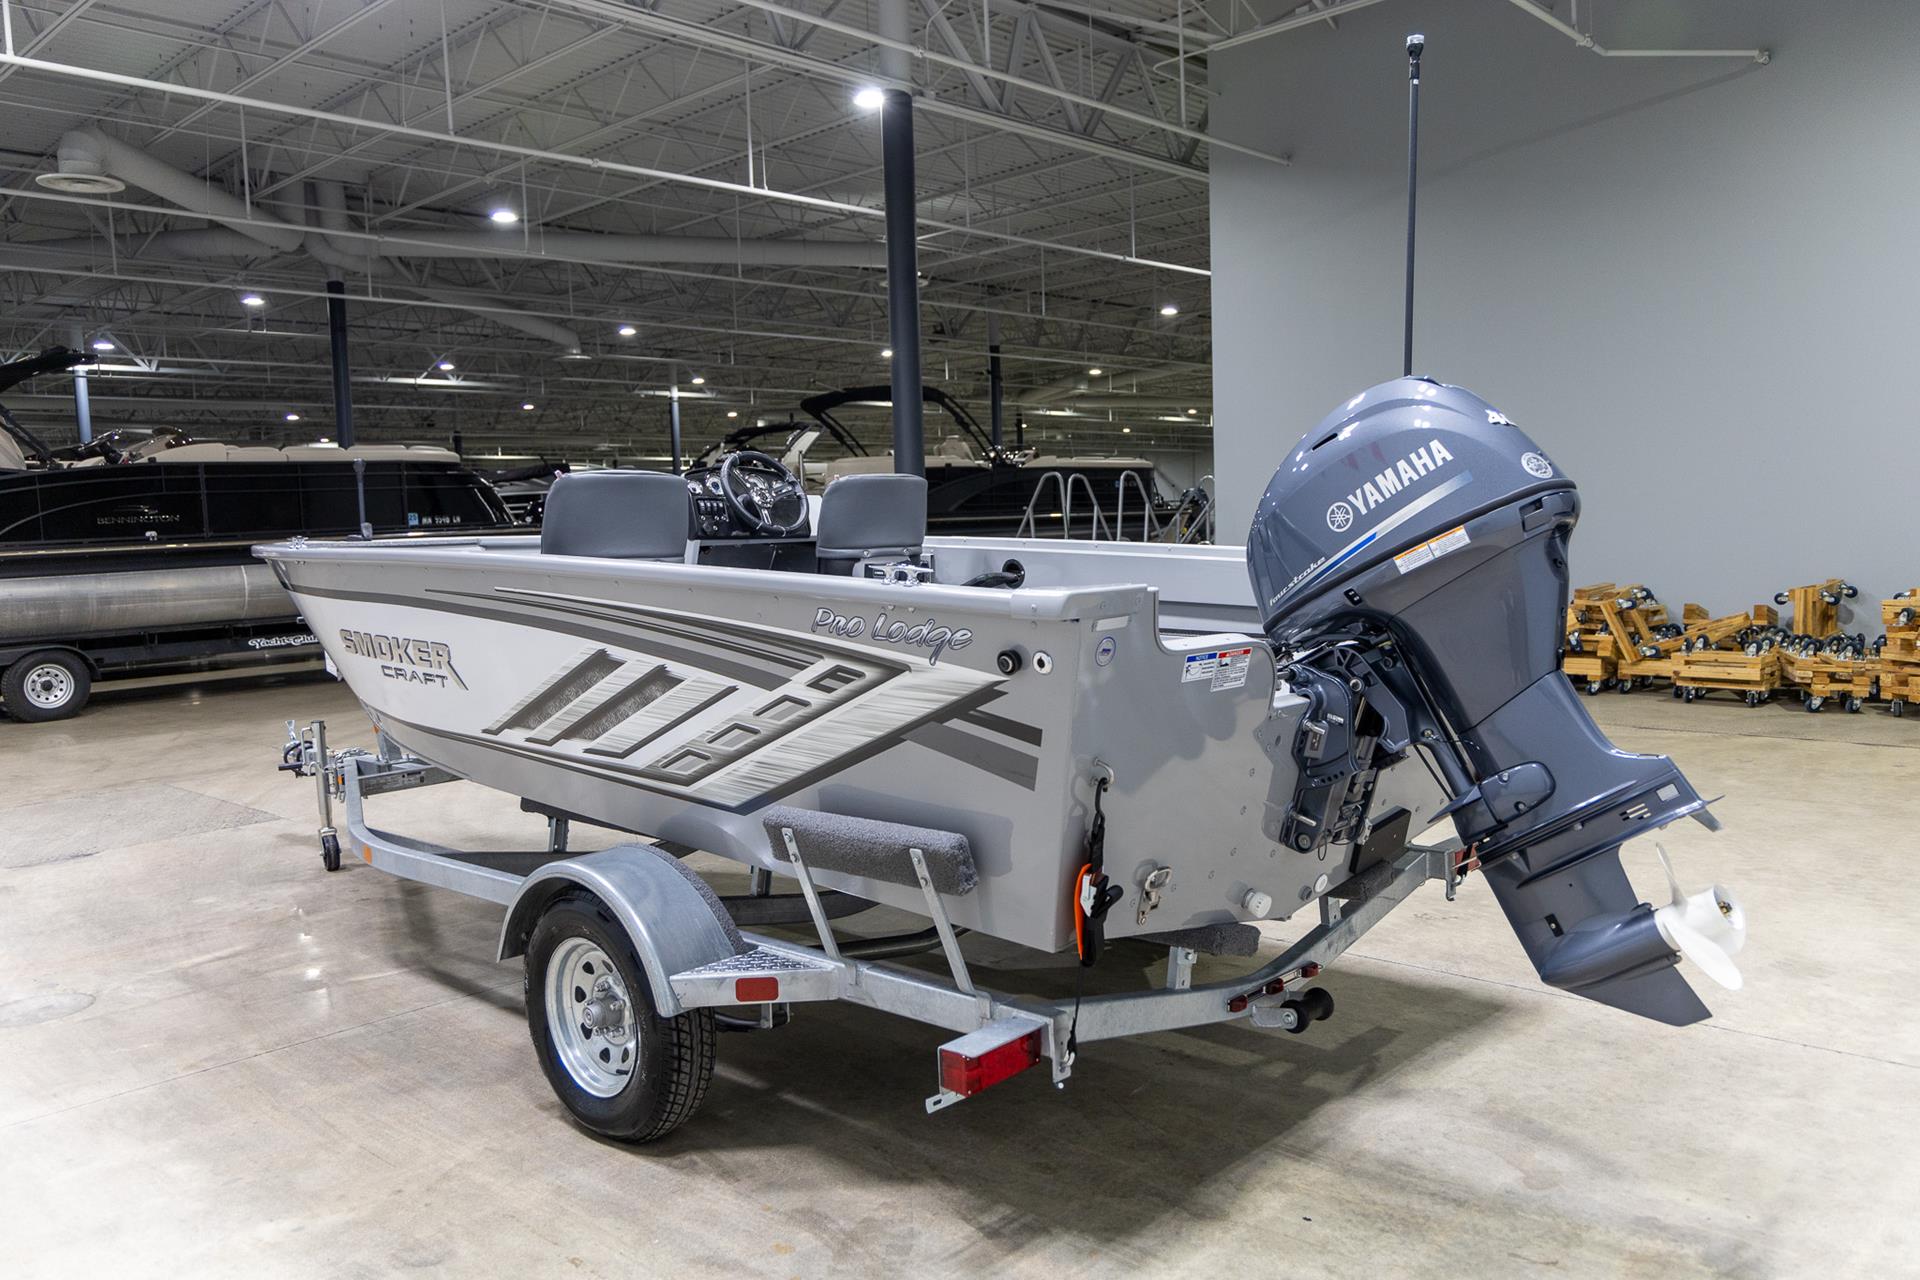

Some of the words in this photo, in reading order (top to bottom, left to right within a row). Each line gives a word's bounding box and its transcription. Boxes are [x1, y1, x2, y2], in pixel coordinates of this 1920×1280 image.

[1347, 439, 1454, 516] YAMAHA
[97, 515, 180, 524] BENNINGTON
[339, 628, 469, 691] SMOKER
[811, 607, 866, 638] Pro
[871, 612, 973, 667] Lodge
[381, 665, 448, 688] CRAFT
